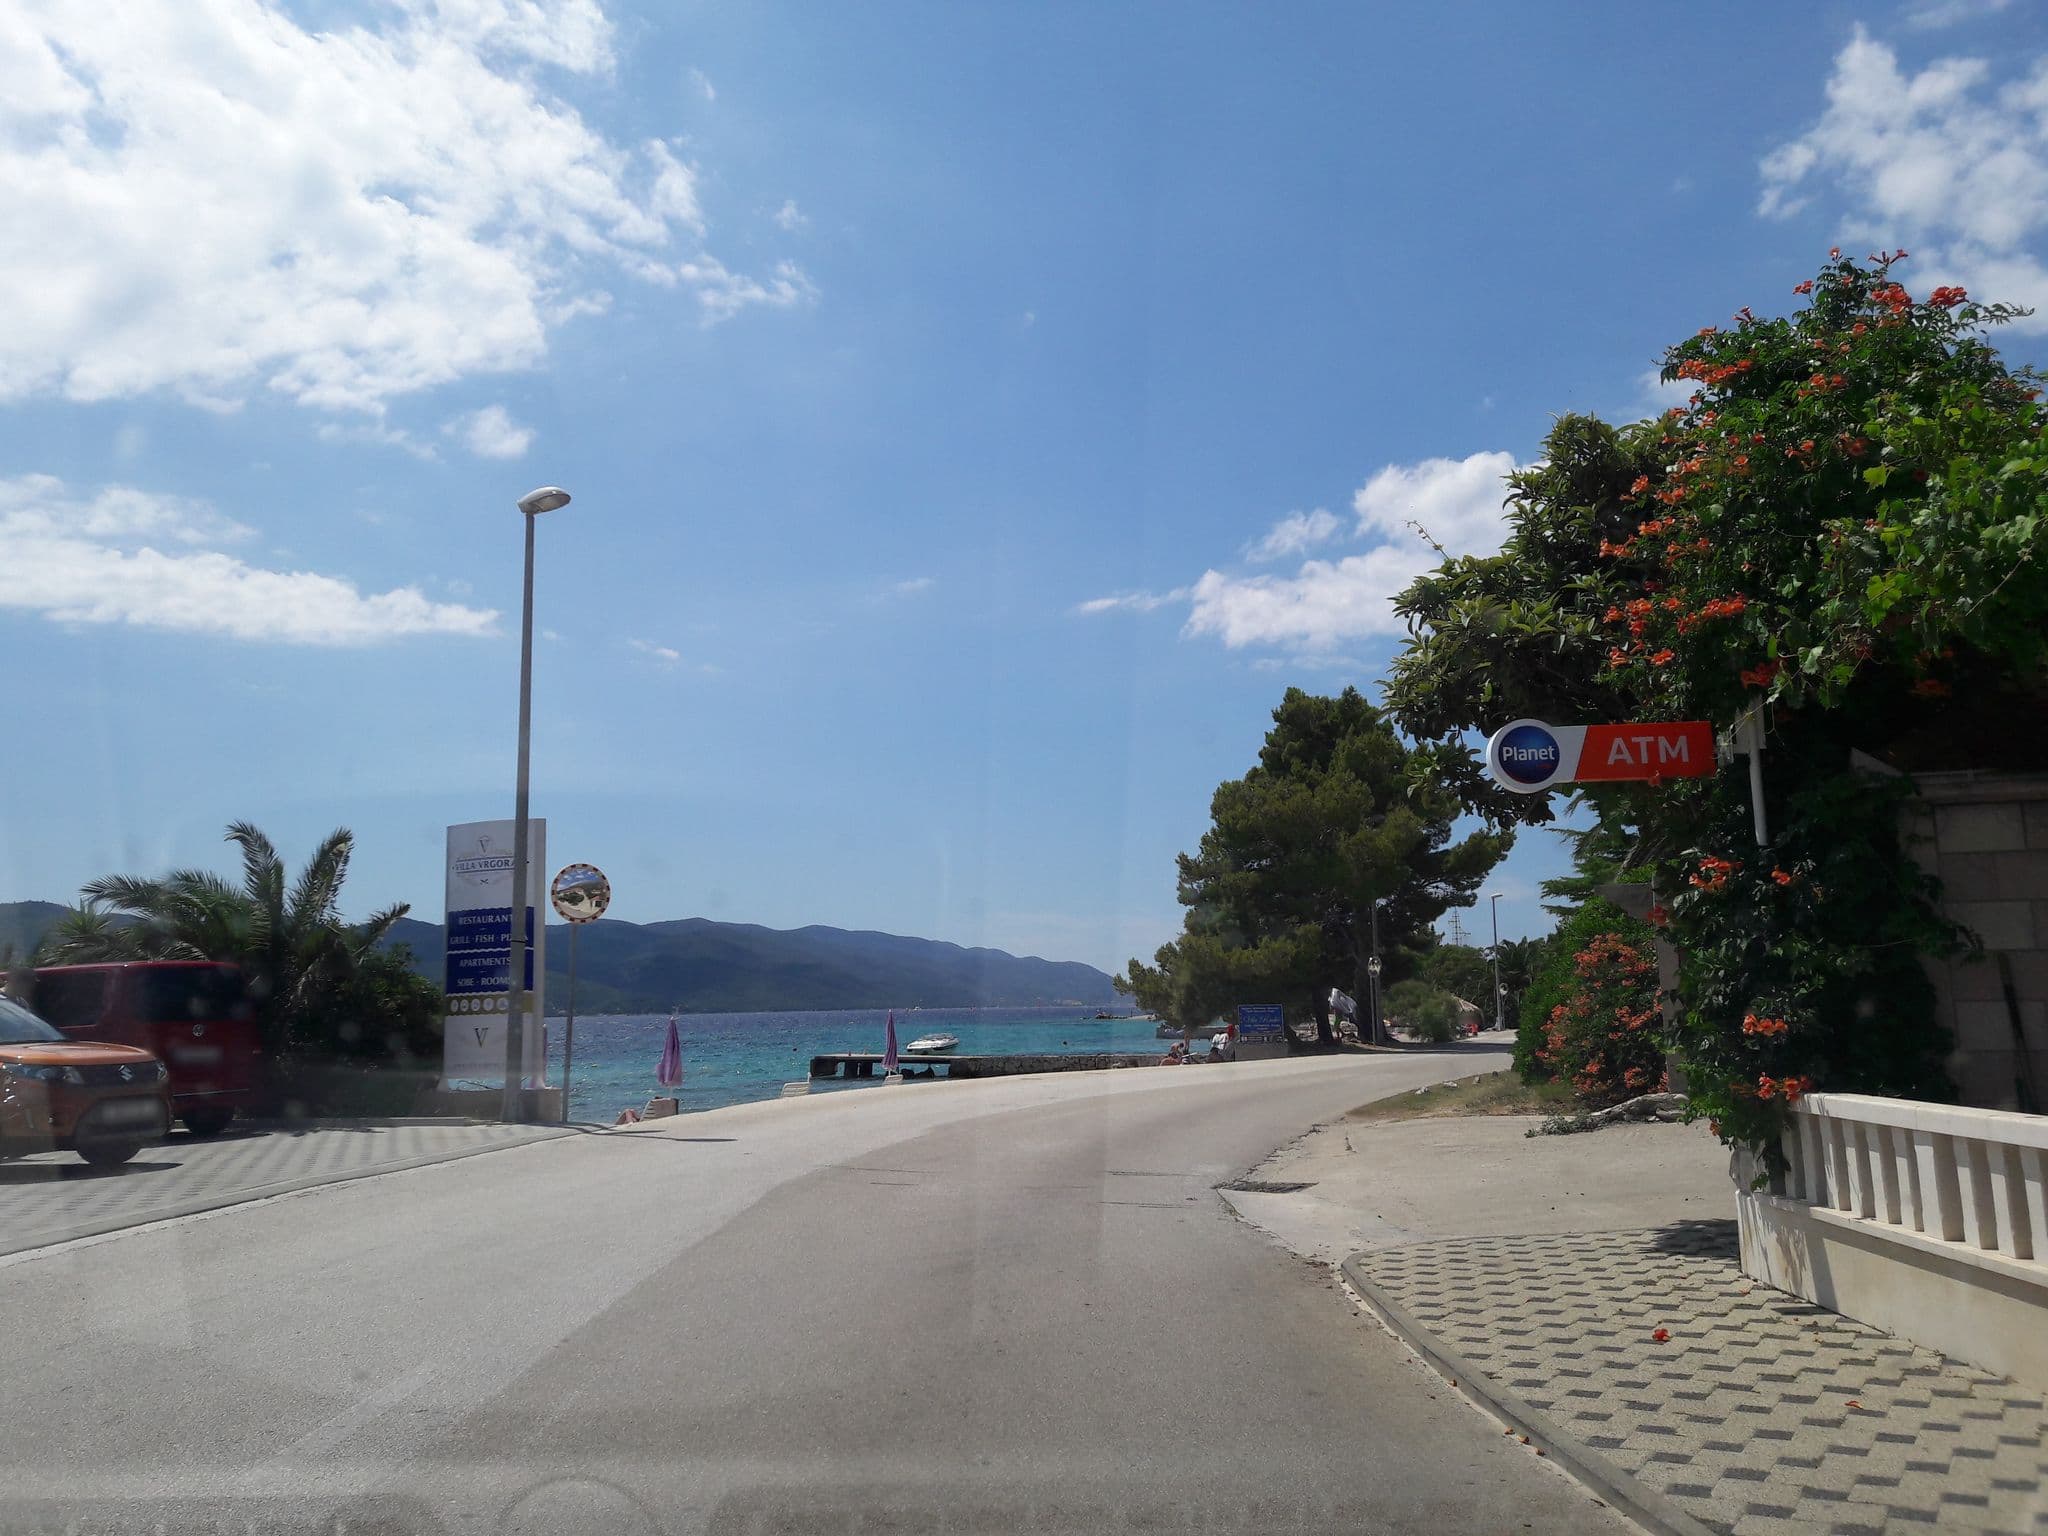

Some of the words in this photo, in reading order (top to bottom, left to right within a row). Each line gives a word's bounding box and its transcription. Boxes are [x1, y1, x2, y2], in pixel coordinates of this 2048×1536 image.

[1502, 745, 1557, 762] Planet
[1607, 735, 1688, 766] ATM
[456, 862, 476, 871] VILLA
[450, 935, 470, 944] GRILL
[475, 934, 494, 943] FISH
[459, 957, 512, 967] APARTMENTS
